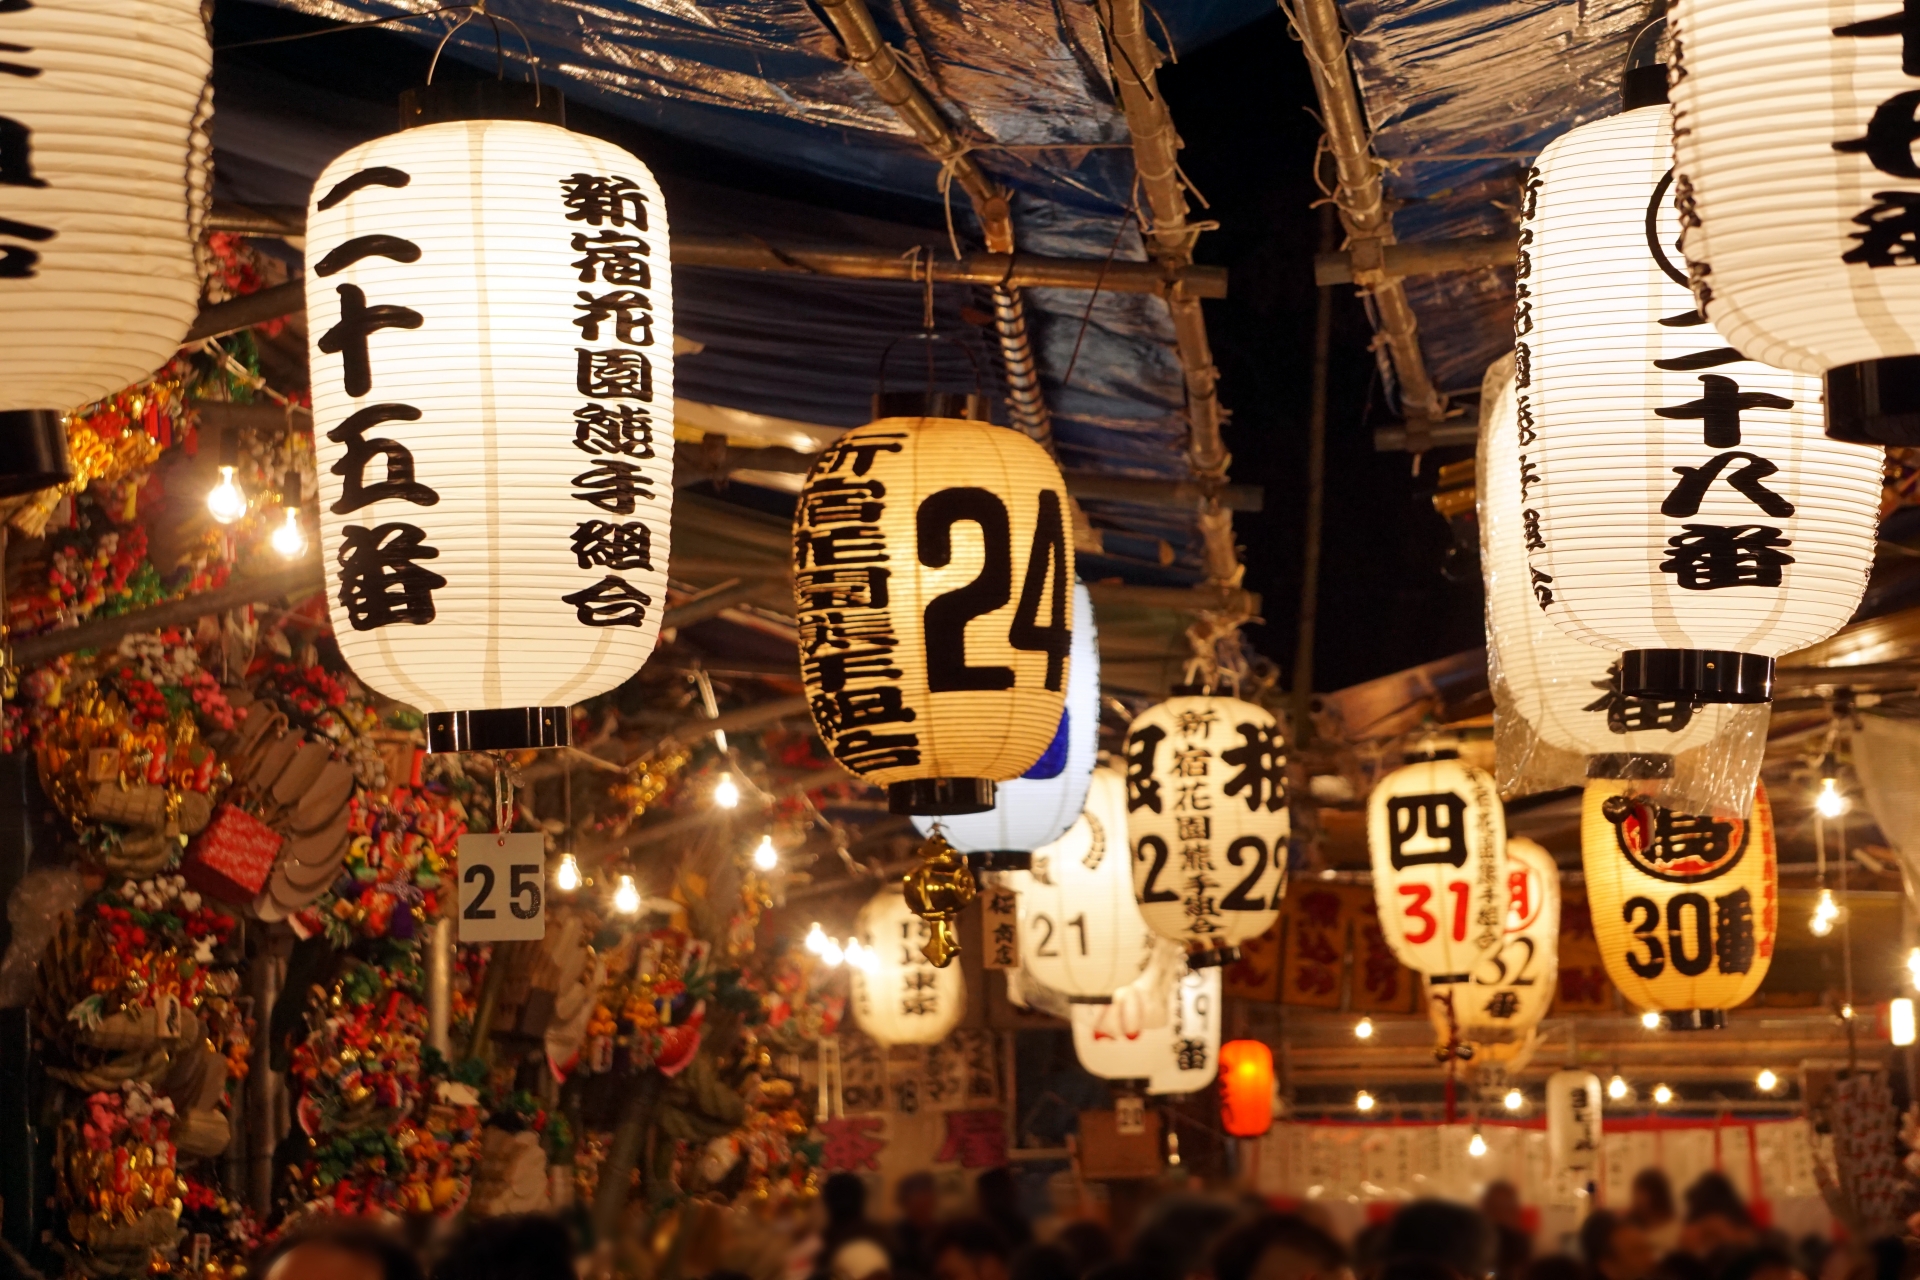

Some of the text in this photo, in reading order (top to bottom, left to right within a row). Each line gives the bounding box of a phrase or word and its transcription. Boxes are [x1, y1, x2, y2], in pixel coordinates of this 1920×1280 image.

[315, 167, 447, 631] 二十五番
[560, 173, 656, 628] 新宿花園熊手組合
[1654, 309, 1795, 590] 二十八番
[916, 487, 1071, 692] 24
[463, 864, 541, 921] 25
[1171, 710, 1223, 935] 新宿花園熊手組合
[1387, 791, 1468, 871] 四
[1397, 882, 1470, 944] 31
[1031, 914, 1089, 958] 21
